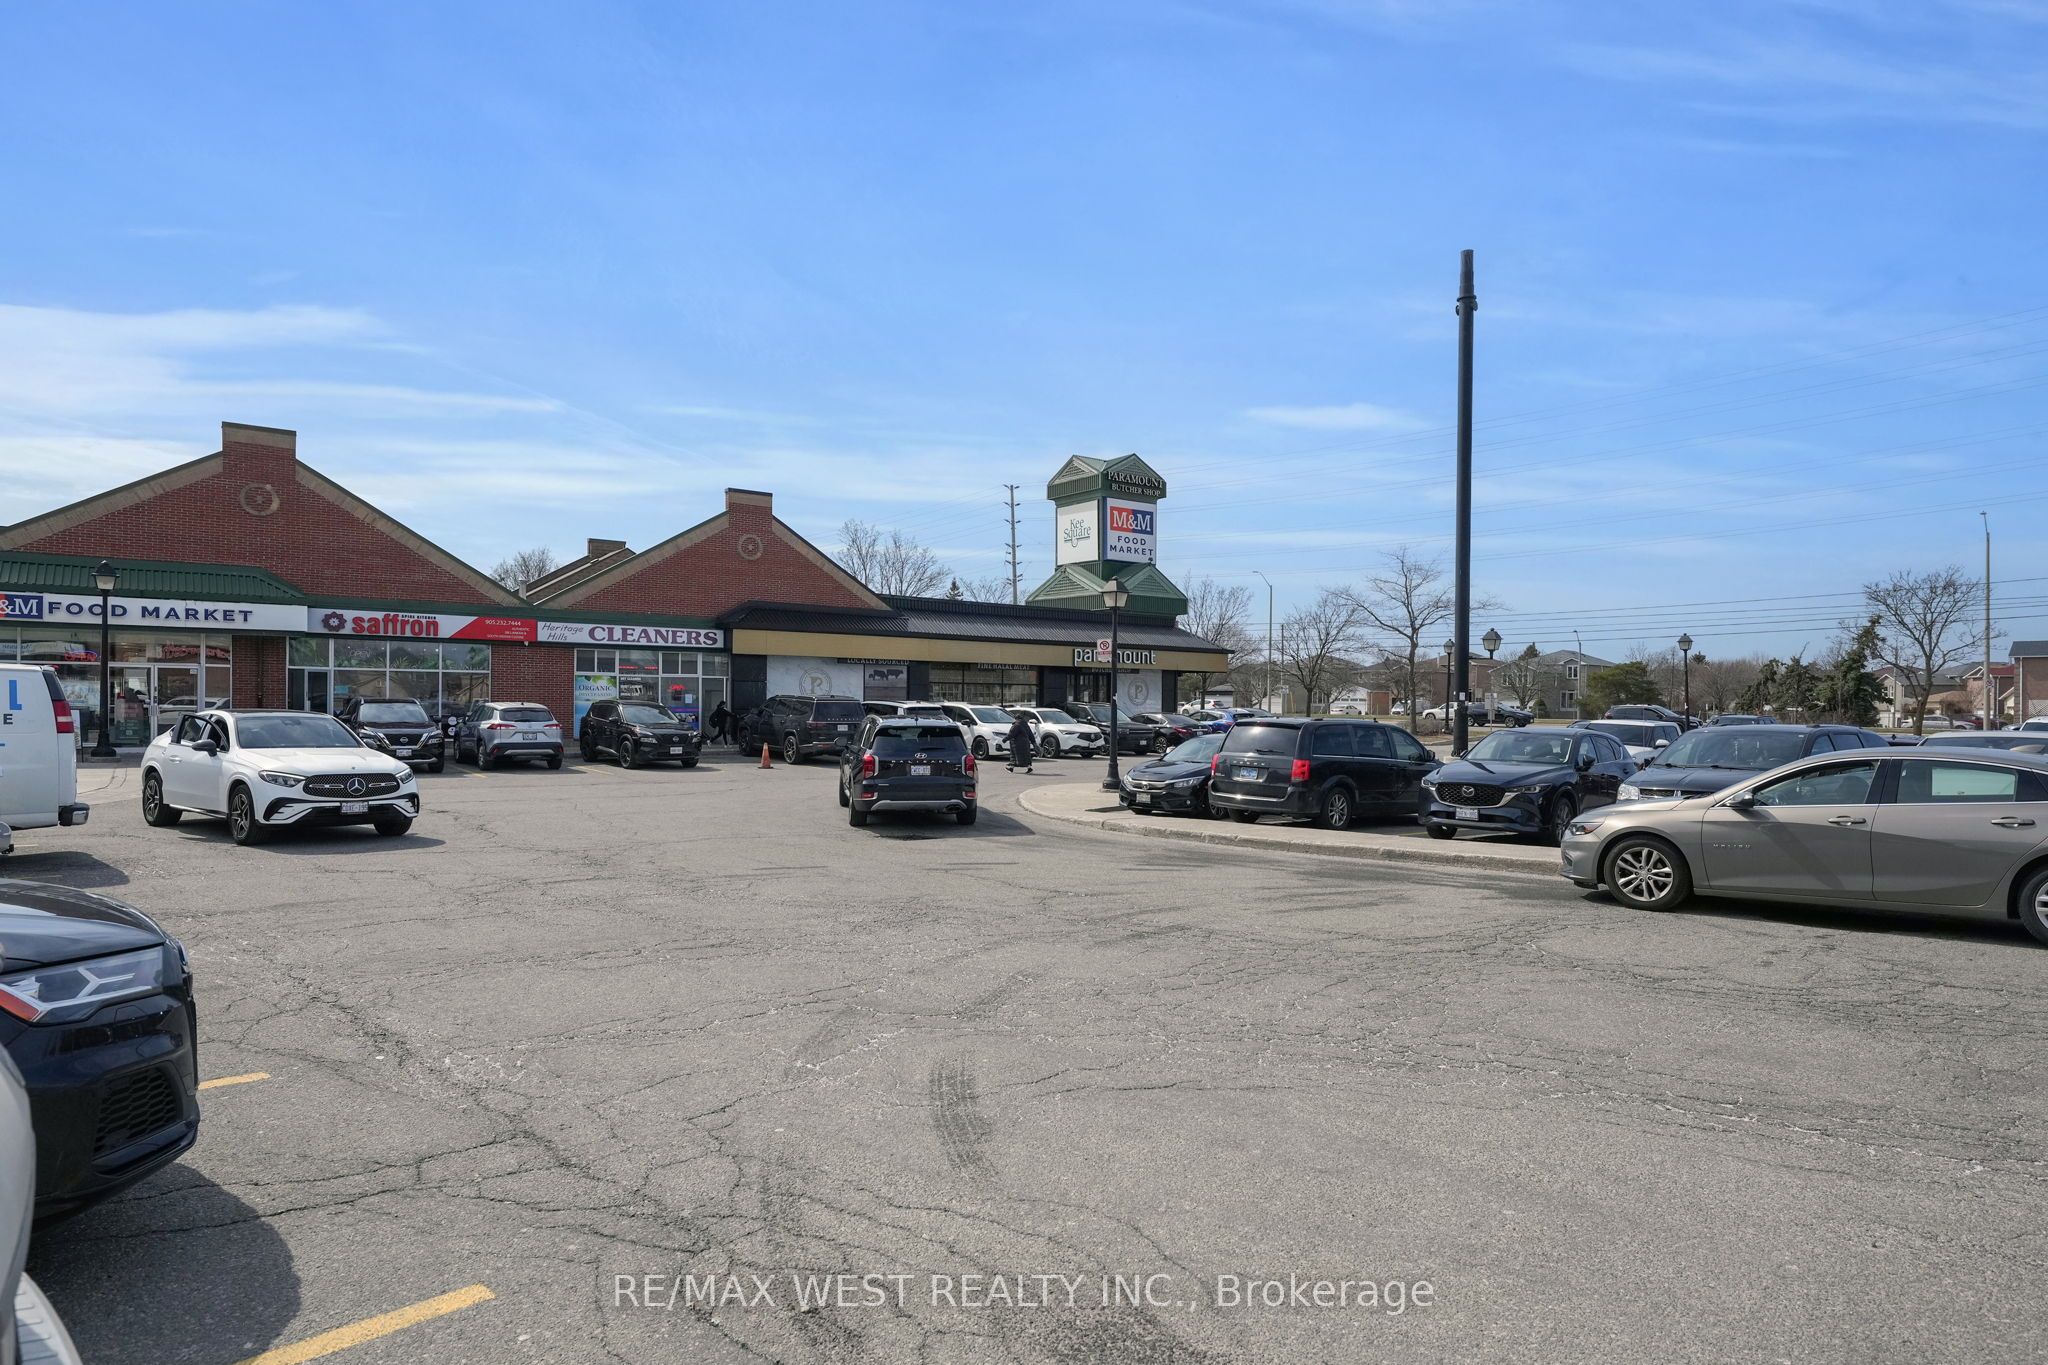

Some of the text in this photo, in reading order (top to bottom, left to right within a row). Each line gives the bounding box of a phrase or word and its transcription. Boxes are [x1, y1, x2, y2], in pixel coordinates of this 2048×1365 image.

[1108, 471, 1163, 488] PARAMOUNT
[1112, 483, 1160, 497] BUTCHER SHOP
[1070, 519, 1084, 529] Kee
[1112, 510, 1151, 531] M&M
[1064, 526, 1091, 543] Square
[1118, 536, 1146, 546] FOOD
[1110, 544, 1154, 556] MARKET
[48, 602, 128, 616] FOOD
[141, 606, 253, 622] MARKET
[352, 613, 439, 636] saffron
[542, 622, 584, 634] Heritage
[547, 632, 568, 641] Hills
[588, 626, 718, 646] CLEANERS
